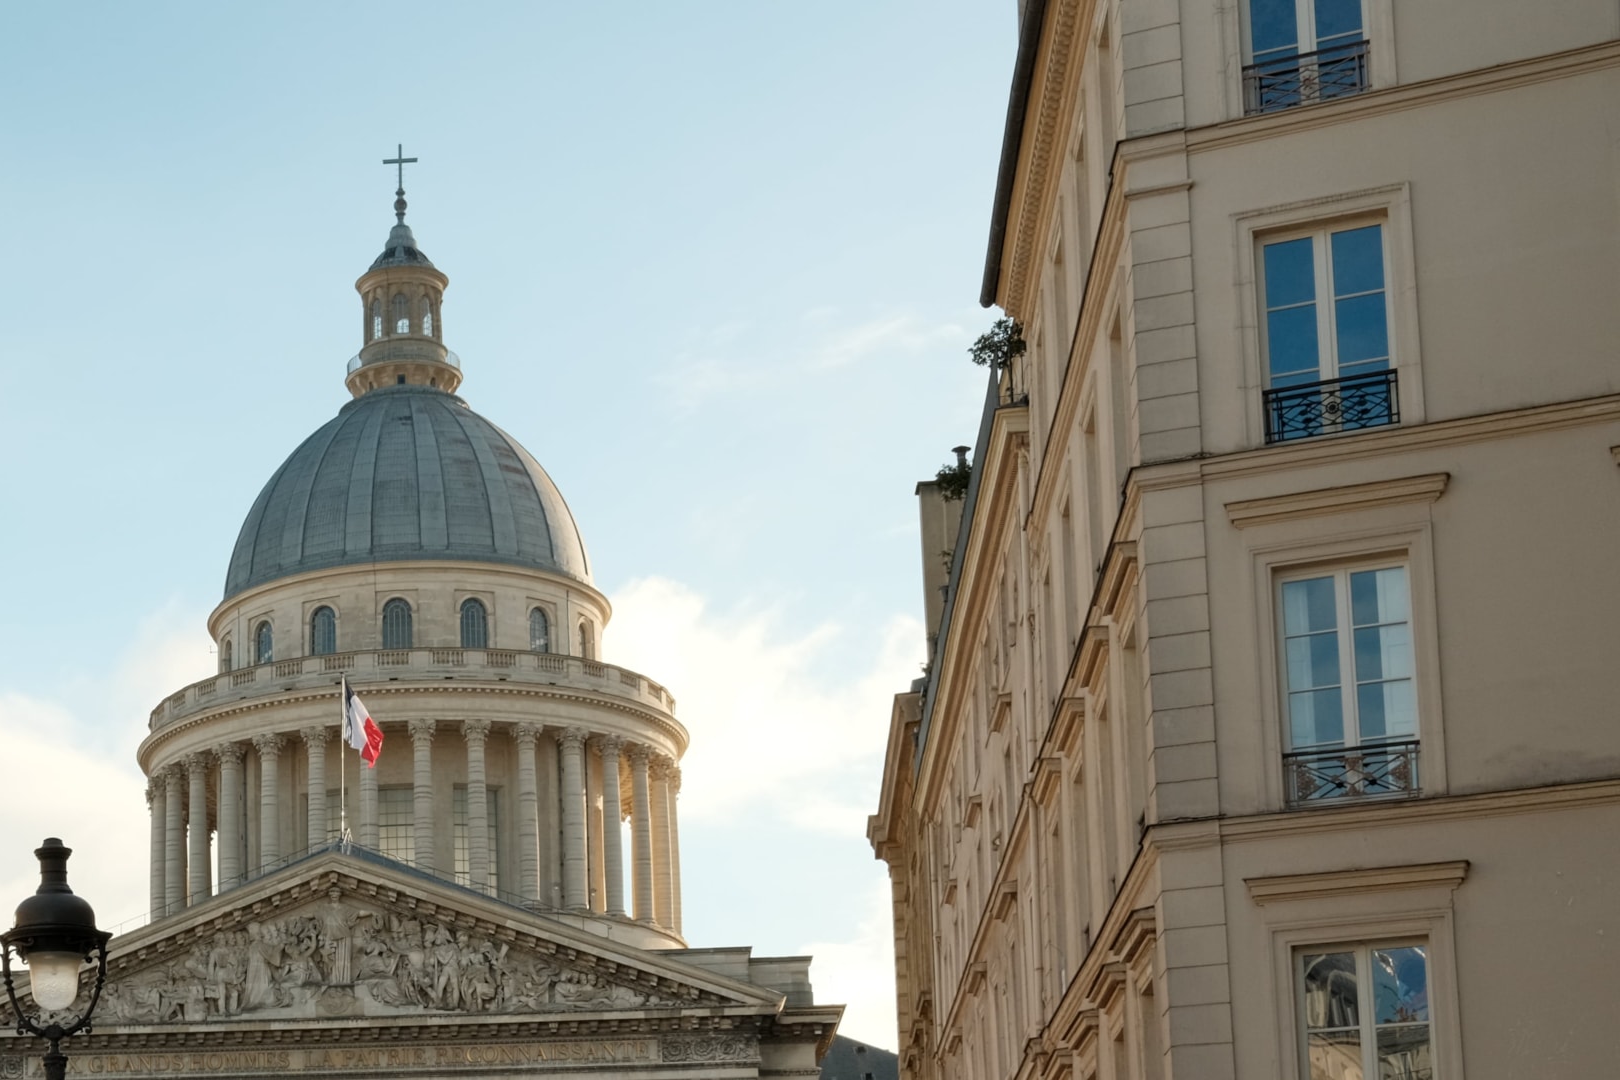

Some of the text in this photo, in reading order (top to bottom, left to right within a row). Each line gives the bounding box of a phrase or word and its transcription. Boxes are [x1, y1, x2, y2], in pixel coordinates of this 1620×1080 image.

[88, 1054, 185, 1074] GRANDS
[190, 1051, 290, 1073] HOMMES
[304, 1048, 336, 1069] LA
[343, 1046, 427, 1068] PATRIE
[435, 1040, 651, 1066] RECONNAISSANTE
